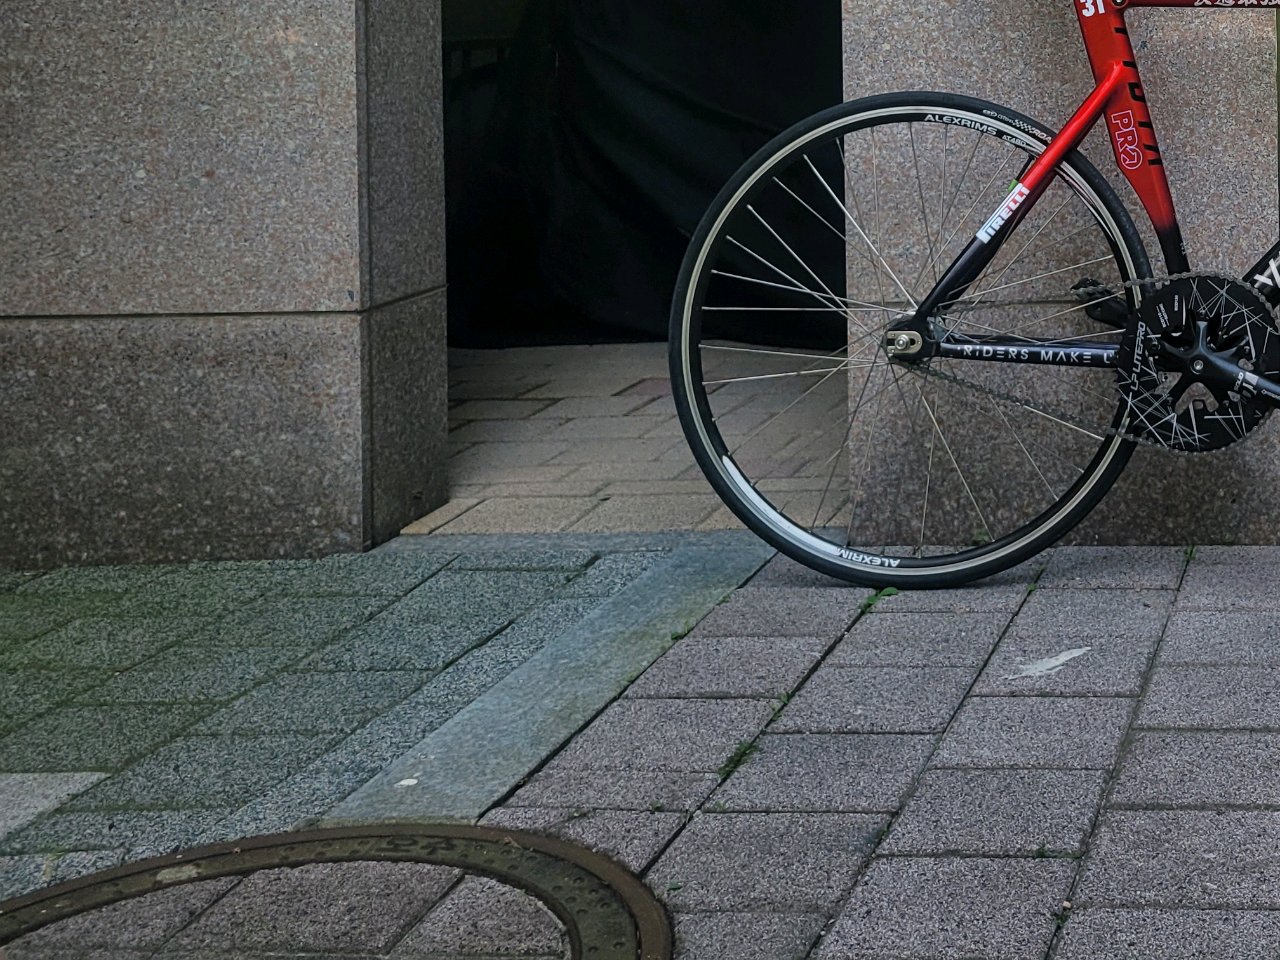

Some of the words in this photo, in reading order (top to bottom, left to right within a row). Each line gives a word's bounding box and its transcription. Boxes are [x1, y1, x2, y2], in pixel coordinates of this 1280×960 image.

[924, 114, 998, 136] ALEXRIMS
[1111, 110, 1143, 170] PRO
[975, 182, 1031, 245] PIRELLI
[962, 344, 1029, 360] RIDERS
[1040, 350, 1092, 363] MAKE
